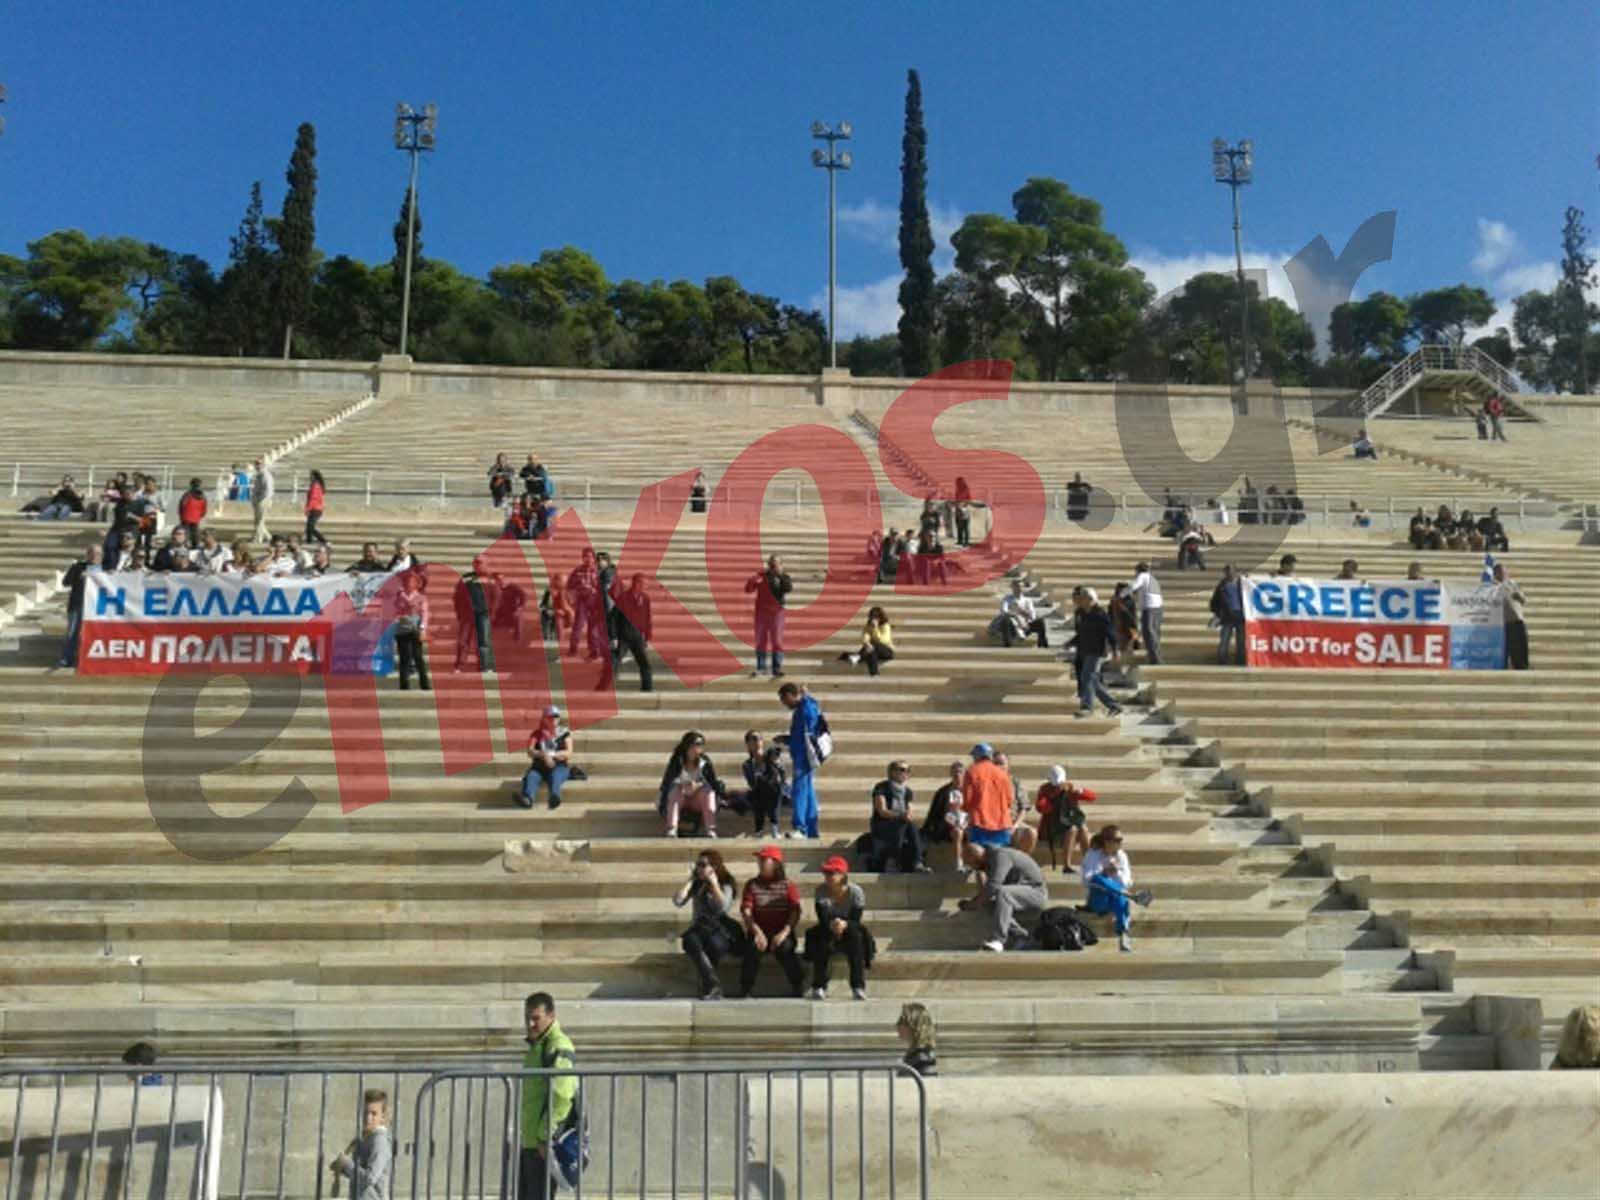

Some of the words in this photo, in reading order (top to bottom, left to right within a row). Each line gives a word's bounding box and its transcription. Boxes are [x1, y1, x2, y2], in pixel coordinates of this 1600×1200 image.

[96, 587, 126, 616] Η
[144, 587, 322, 616] ΕΛΛΑΔΑ
[1251, 582, 1441, 621] GREECE
[87, 639, 145, 659] ΔΕΝ
[1250, 634, 1269, 652] is
[1272, 637, 1319, 654] NOT
[1321, 637, 1352, 655] for
[1354, 631, 1444, 665] SALE
